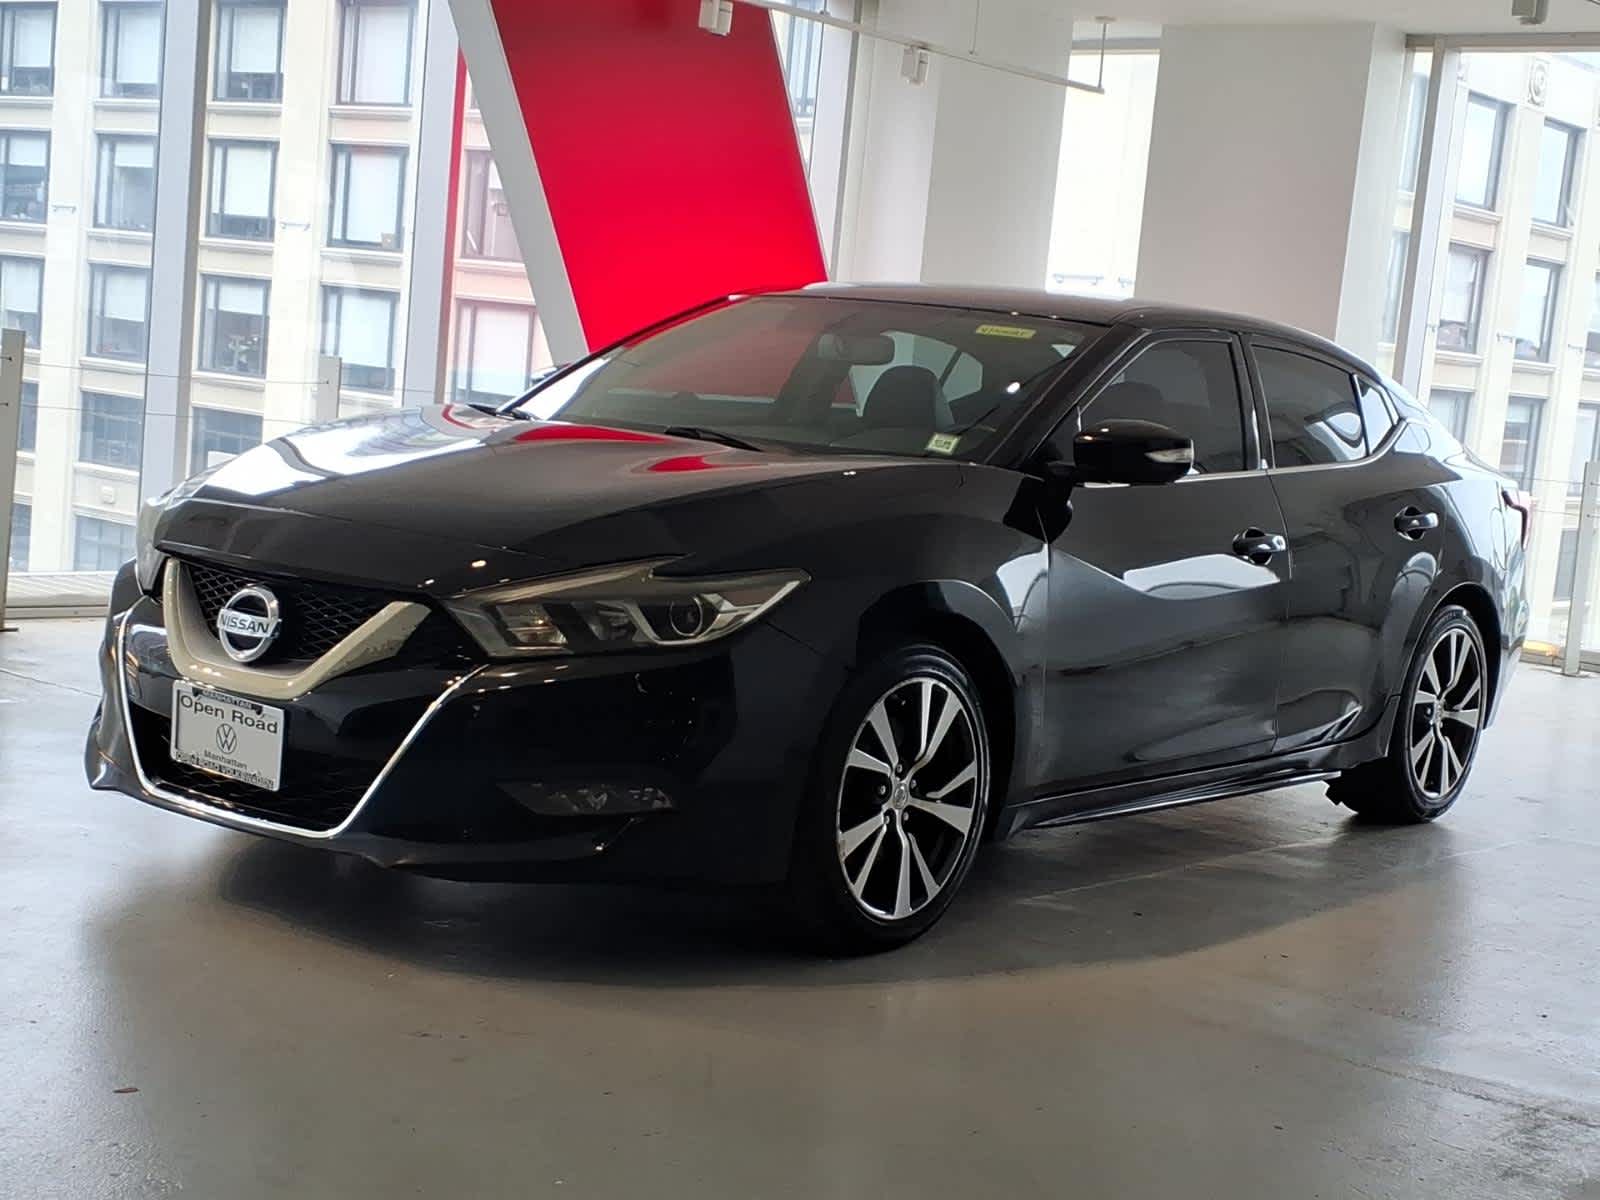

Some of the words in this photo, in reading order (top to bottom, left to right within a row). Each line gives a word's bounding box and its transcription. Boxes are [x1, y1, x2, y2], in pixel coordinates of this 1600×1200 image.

[221, 613, 270, 633] NISSAN
[180, 694, 225, 719] Open
[231, 709, 278, 734] Road
[203, 749, 248, 770] Manhattan
